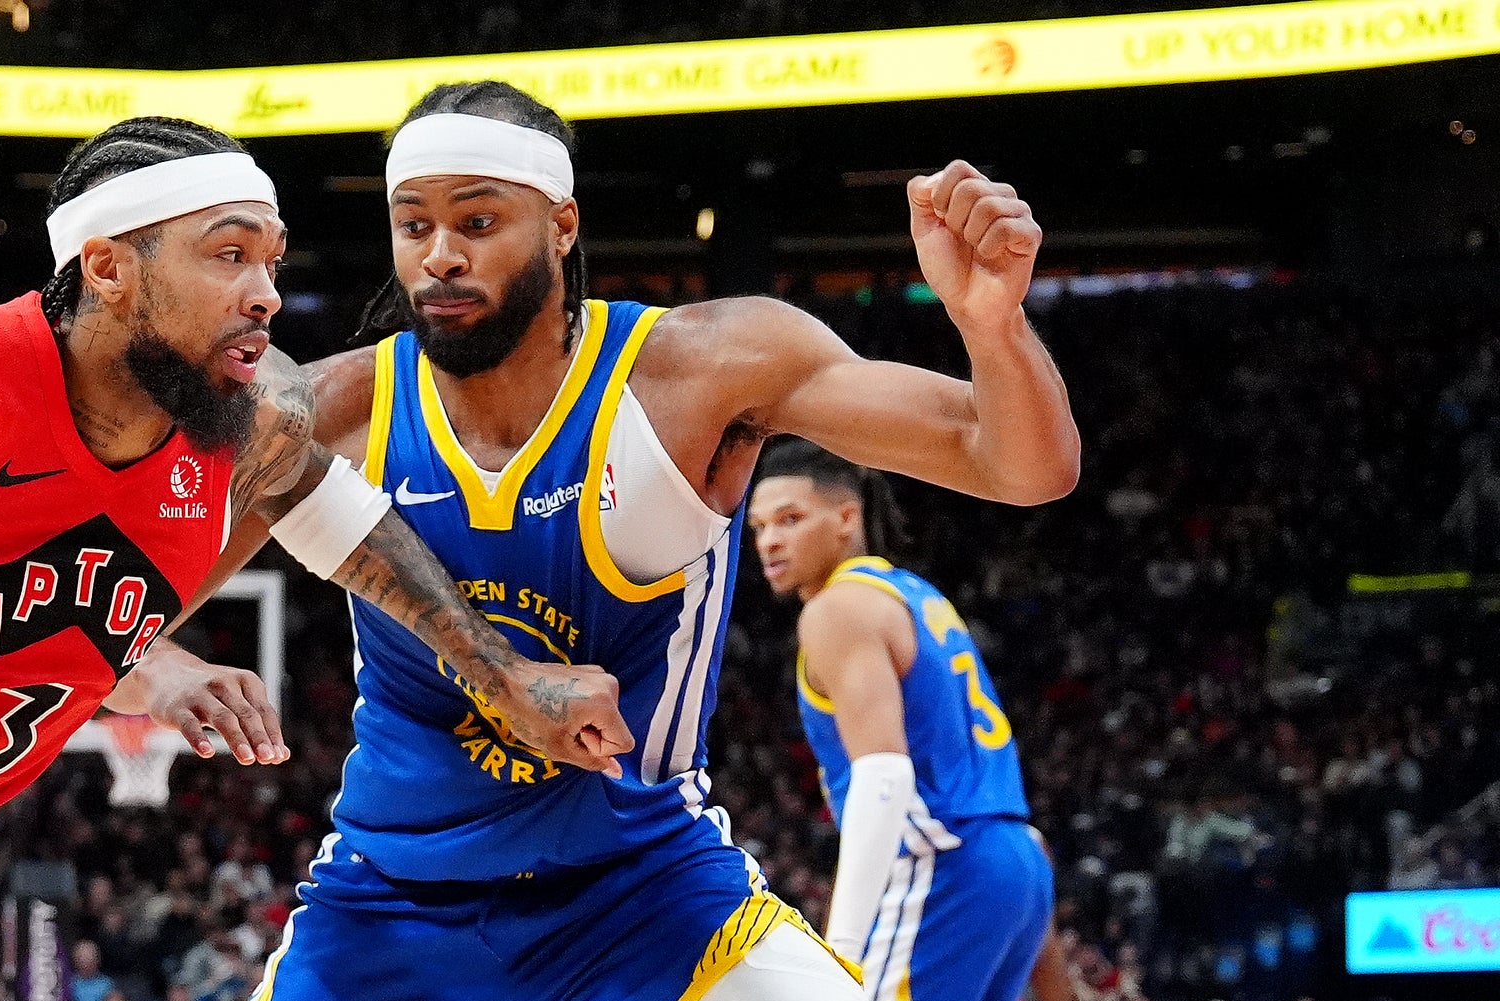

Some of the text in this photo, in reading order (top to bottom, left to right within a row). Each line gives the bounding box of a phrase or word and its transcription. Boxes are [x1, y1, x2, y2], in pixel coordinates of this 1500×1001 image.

[1123, 28, 1185, 69] UP
[1201, 17, 1329, 62] YOUR
[1340, 3, 1472, 49] HOME
[604, 58, 723, 97] HOME
[743, 51, 861, 91] GAME
[20, 84, 132, 120] GAME
[159, 502, 207, 518] Sun Life
[460, 579, 580, 647] DEN STATE
[950, 650, 1013, 750] 3
[1422, 905, 1500, 953] Coo
